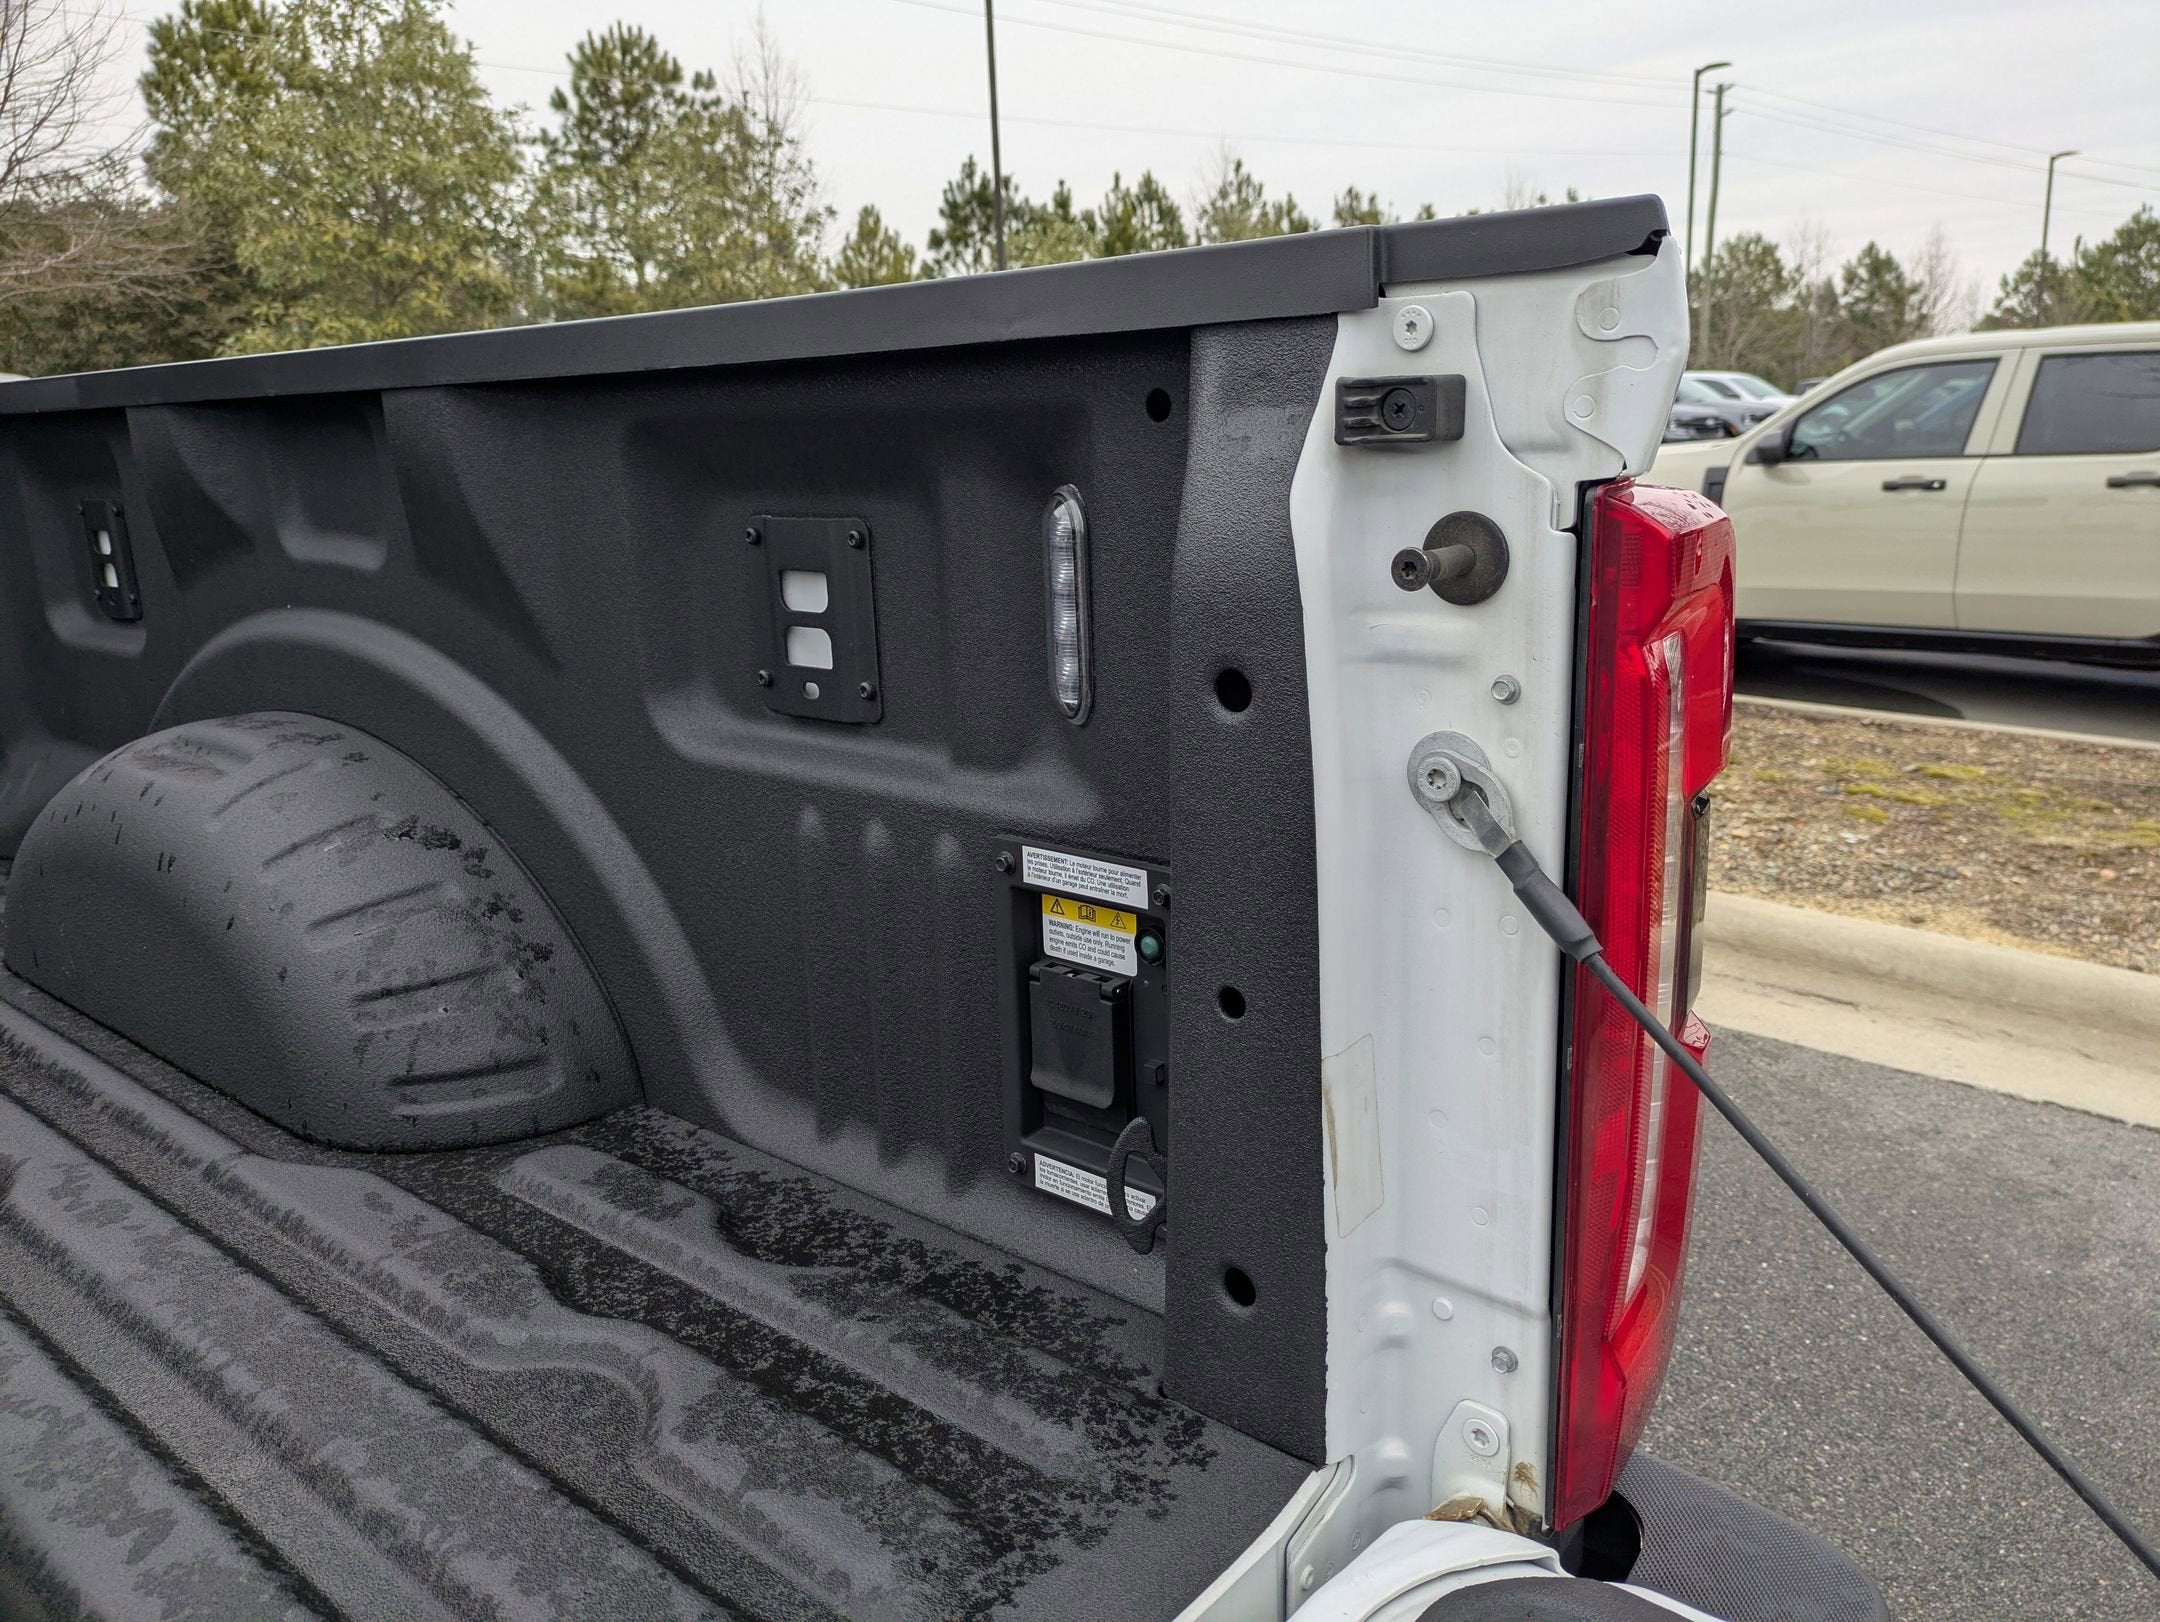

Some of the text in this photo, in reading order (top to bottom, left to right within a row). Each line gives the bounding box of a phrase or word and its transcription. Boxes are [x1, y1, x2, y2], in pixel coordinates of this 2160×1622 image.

[1032, 866, 1047, 874] moteur
[1097, 879, 1106, 887] Une
[1076, 862, 1091, 870] moteur
[1092, 865, 1107, 873] tourne
[1108, 868, 1119, 876] pour
[1120, 870, 1142, 880] alimenter
[1062, 879, 1077, 888] garage
[1124, 878, 1141, 887] Quand
[1048, 919, 1075, 931] WARNING:
[1075, 925, 1091, 935] Engine
[1116, 936, 1130, 944] power
[1049, 937, 1064, 945] engine
[1065, 941, 1077, 949] emits
[1111, 952, 1125, 960] cause
[1050, 944, 1062, 952] death
[1067, 949, 1078, 957] used
[1079, 951, 1092, 960] inside
[1066, 933, 1082, 941] outside
[1105, 940, 1125, 954] Running
